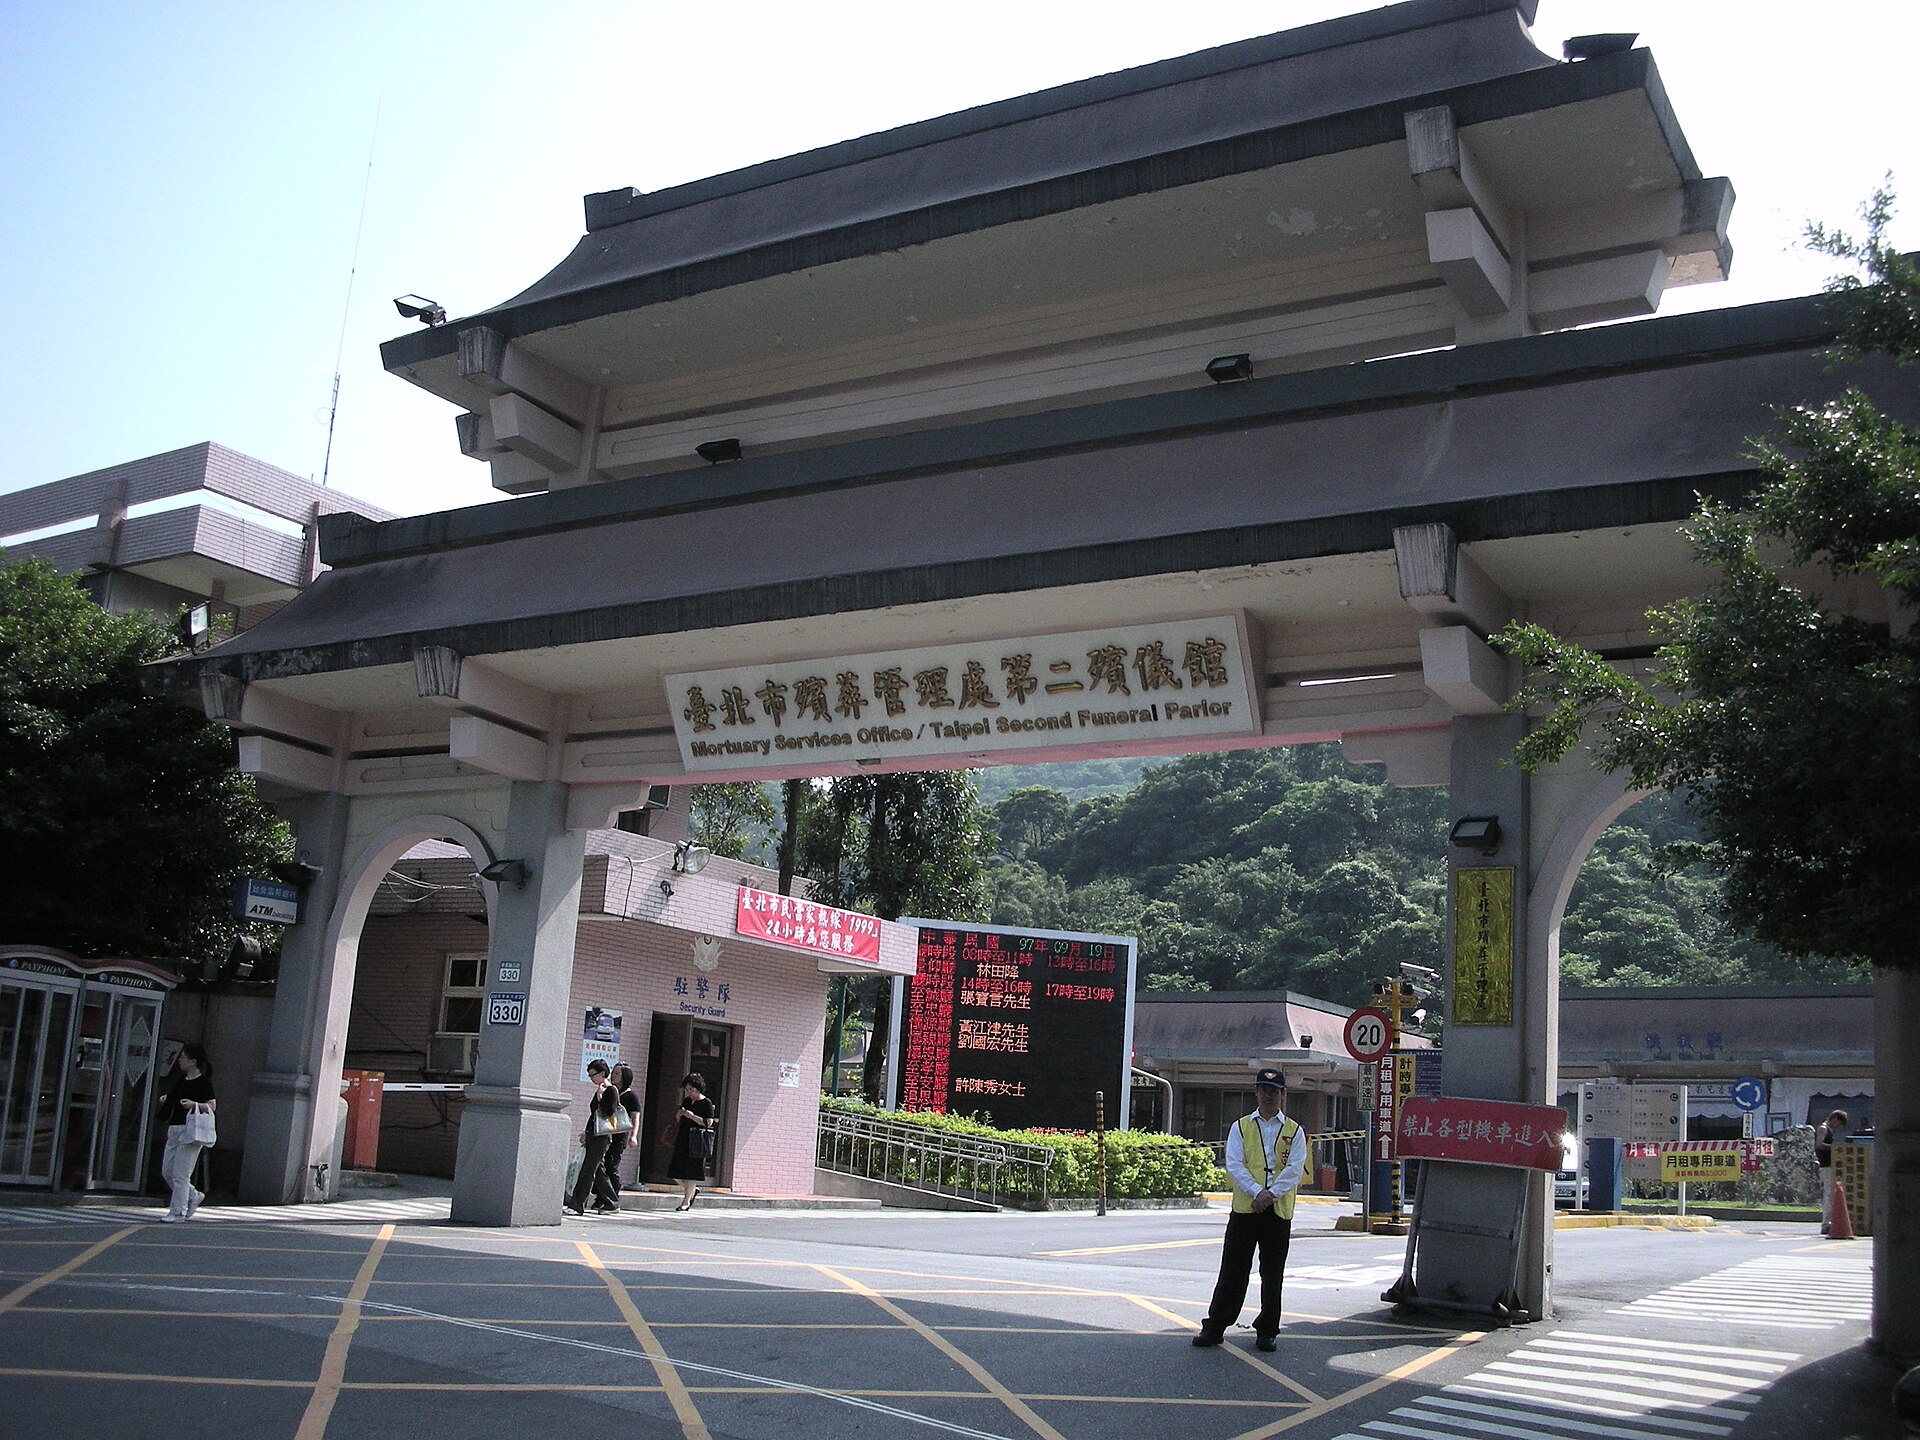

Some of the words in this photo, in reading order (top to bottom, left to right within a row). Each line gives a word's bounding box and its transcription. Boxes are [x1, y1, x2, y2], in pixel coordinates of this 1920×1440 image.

[684, 637, 1229, 733] 臺北市殯葬管理處第二殯儀館
[691, 739, 771, 758] Mortuary
[774, 732, 853, 751] Services
[856, 724, 914, 745] Office
[916, 723, 926, 741] /
[929, 717, 991, 740] Taipei
[995, 712, 1073, 734] Second
[1077, 704, 1159, 728] Funeral
[1164, 699, 1232, 721] Parlor
[250, 904, 274, 916] ATM
[765, 918, 854, 954] 24小時為您服務
[922, 931, 1000, 950] 中華民國
[1019, 938, 1049, 953] 97年
[1054, 940, 1081, 956] 09月
[1089, 944, 1115, 959] 19日
[962, 947, 1033, 966] 08時至11時
[20, 961, 70, 976] PAYPHONE
[501, 970, 518, 980] 330
[109, 975, 154, 989] PAYPHONE
[673, 976, 731, 1004] 駐警隊
[961, 976, 1033, 996] 14時至16時
[1046, 983, 1115, 1002] 17時至19時
[492, 1005, 520, 1021] 330
[679, 1001, 706, 1016] Security
[707, 1006, 726, 1017] Guard
[957, 1034, 1029, 1053] 劉國宏先生
[1356, 1024, 1380, 1046] 20
[955, 1077, 1026, 1097] 許陳秀女士
[1379, 1057, 1393, 1133] 月租專用車道
[1402, 1114, 1555, 1148] 禁止各型機車進入
[1629, 1142, 1657, 1157] 月租
[1756, 1139, 1773, 1154] 月租
[1666, 1154, 1736, 1168] 月租專用車道
